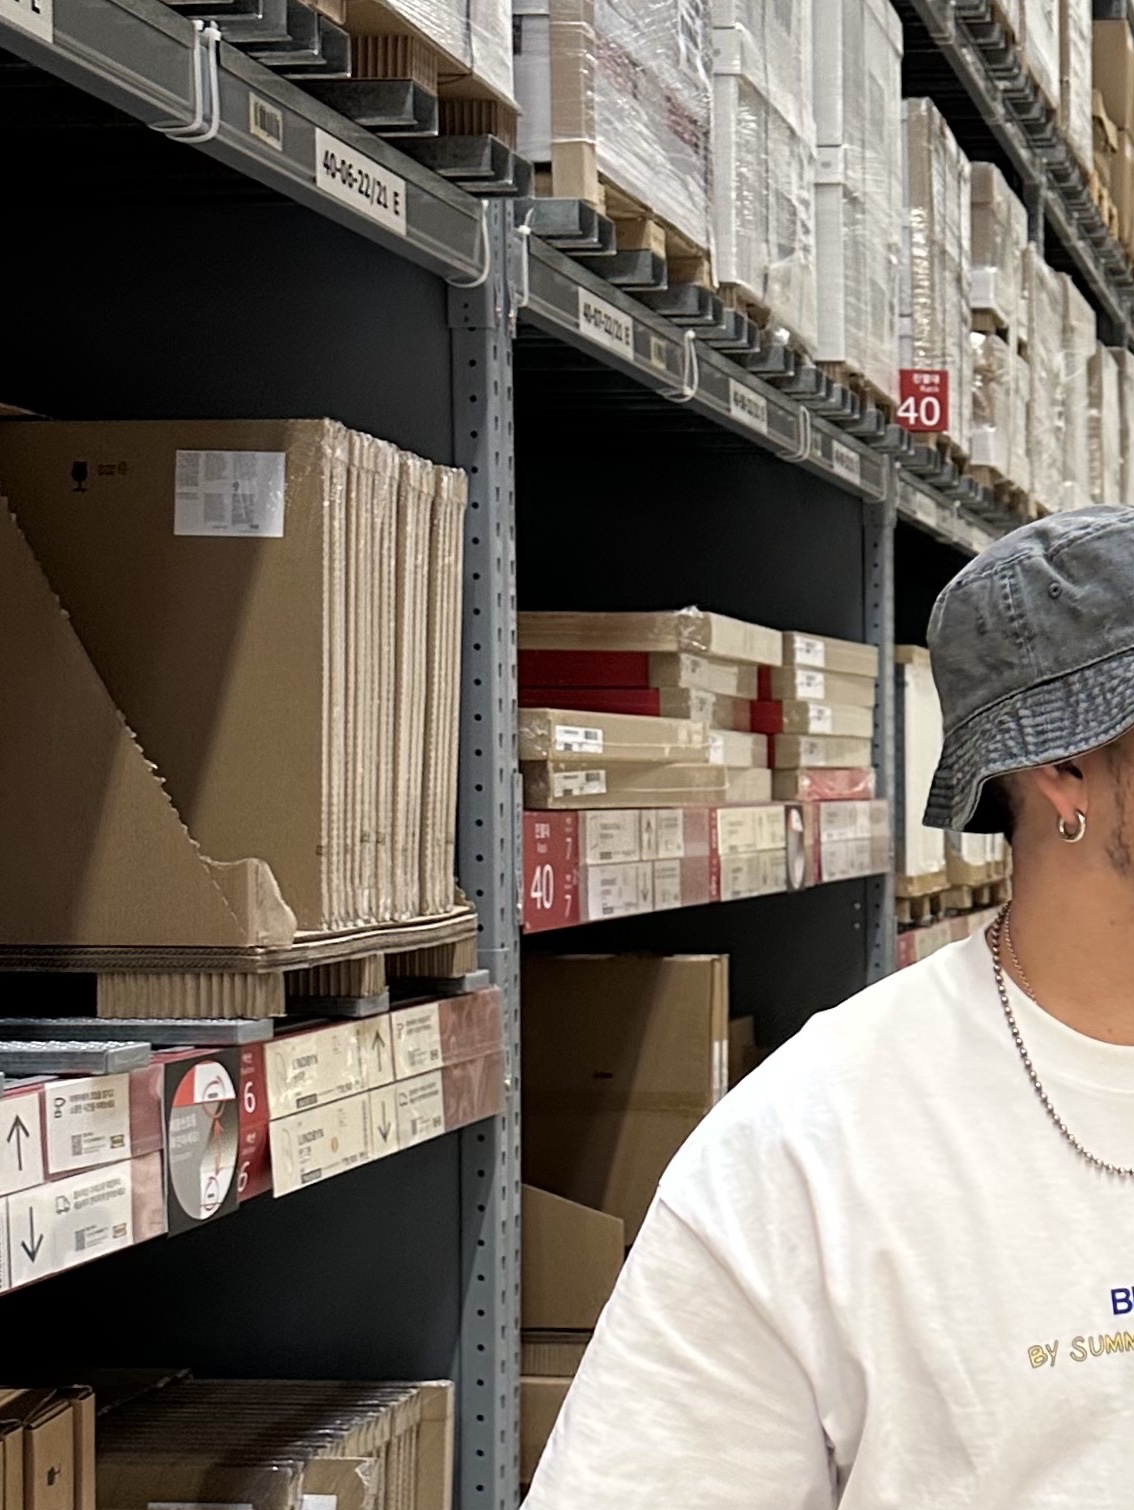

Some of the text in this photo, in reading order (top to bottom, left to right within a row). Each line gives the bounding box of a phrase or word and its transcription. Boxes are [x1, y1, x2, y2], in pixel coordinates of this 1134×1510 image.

[323, 149, 400, 216] 40-06-22/21 E
[896, 395, 941, 427] 40
[565, 837, 572, 860] 7
[530, 863, 554, 910] 40
[564, 894, 572, 918] 7
[243, 1080, 256, 1114] 6
[237, 1160, 250, 1193] 6
[1027, 1339, 1060, 1369] BY
